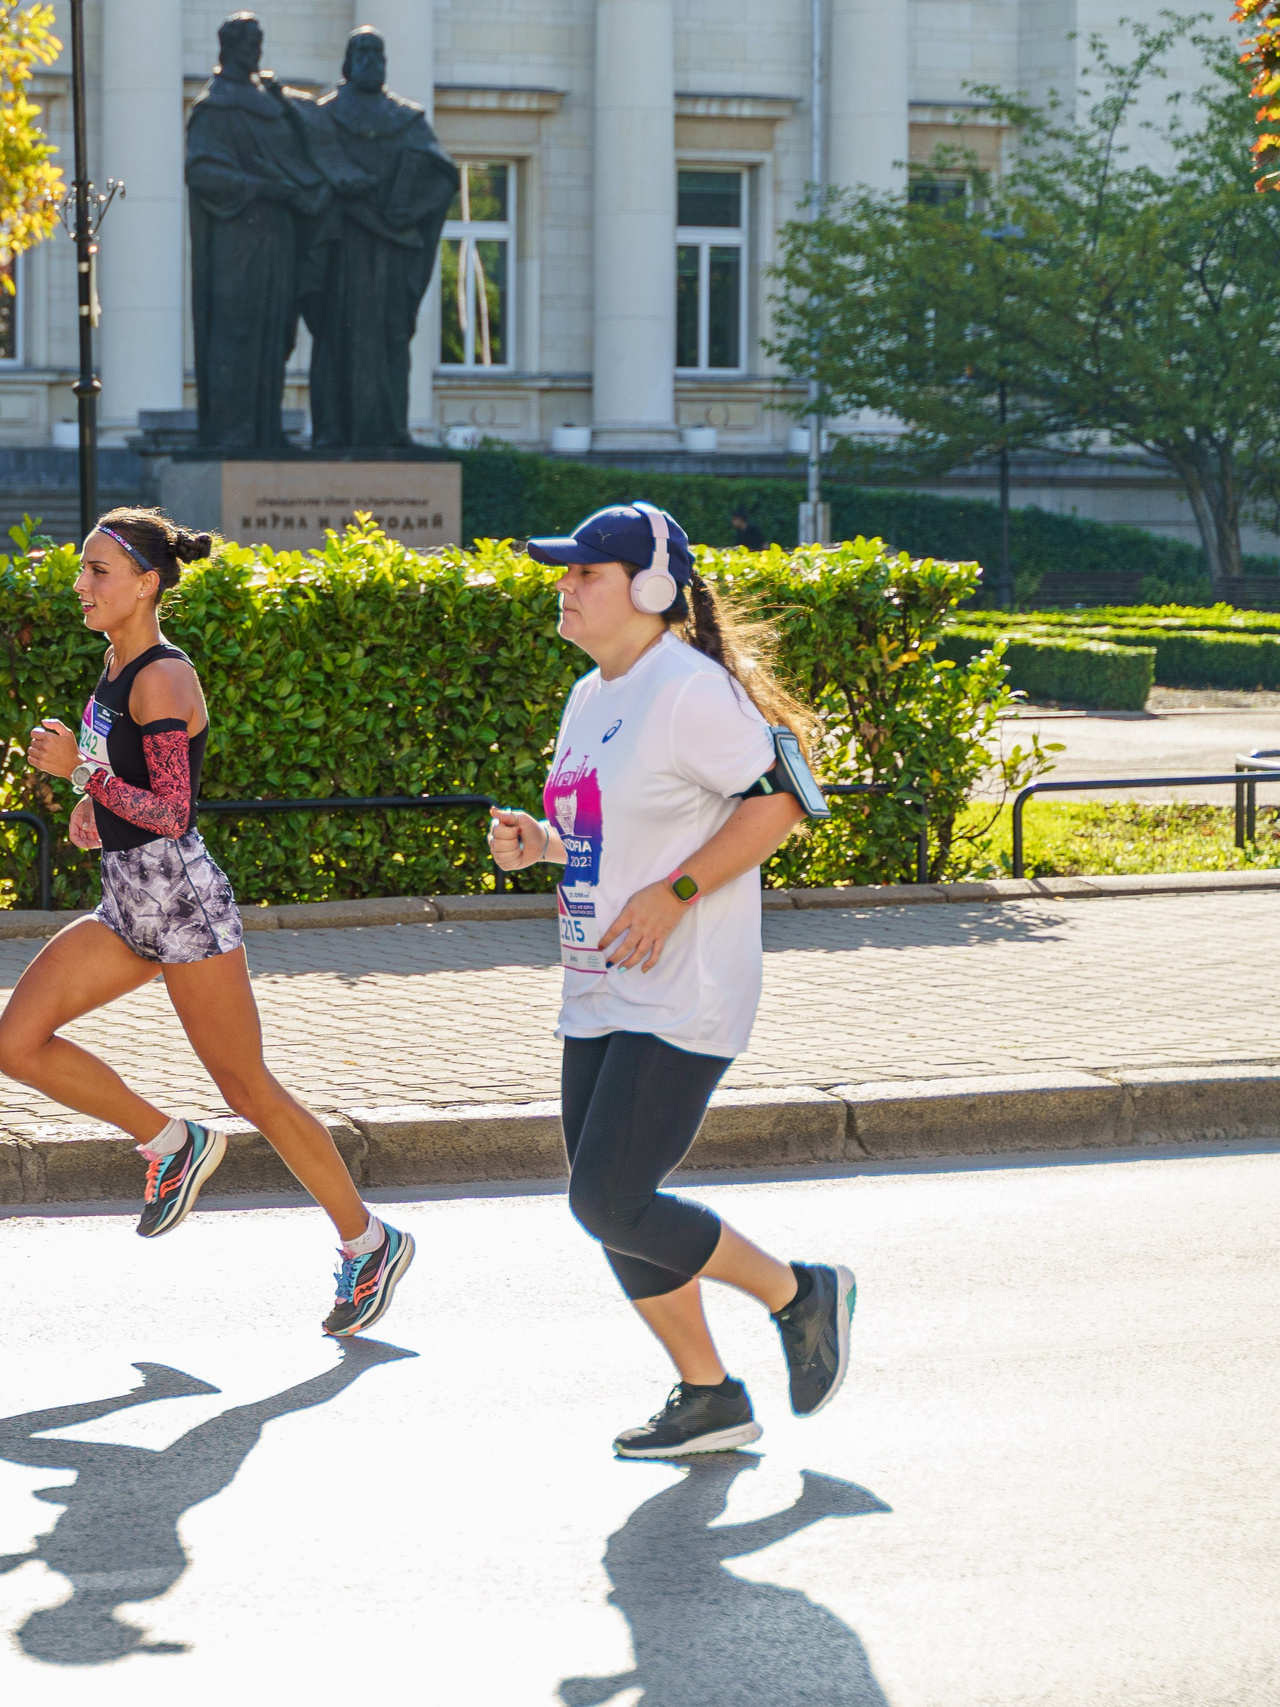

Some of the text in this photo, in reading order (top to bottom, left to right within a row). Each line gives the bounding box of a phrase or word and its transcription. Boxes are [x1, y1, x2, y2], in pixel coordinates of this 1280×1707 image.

[242, 512, 443, 531] КИРИЛ И МТОДИЙ
[101, 526, 133, 551] ARMOUR
[570, 856, 592, 868] 2023
